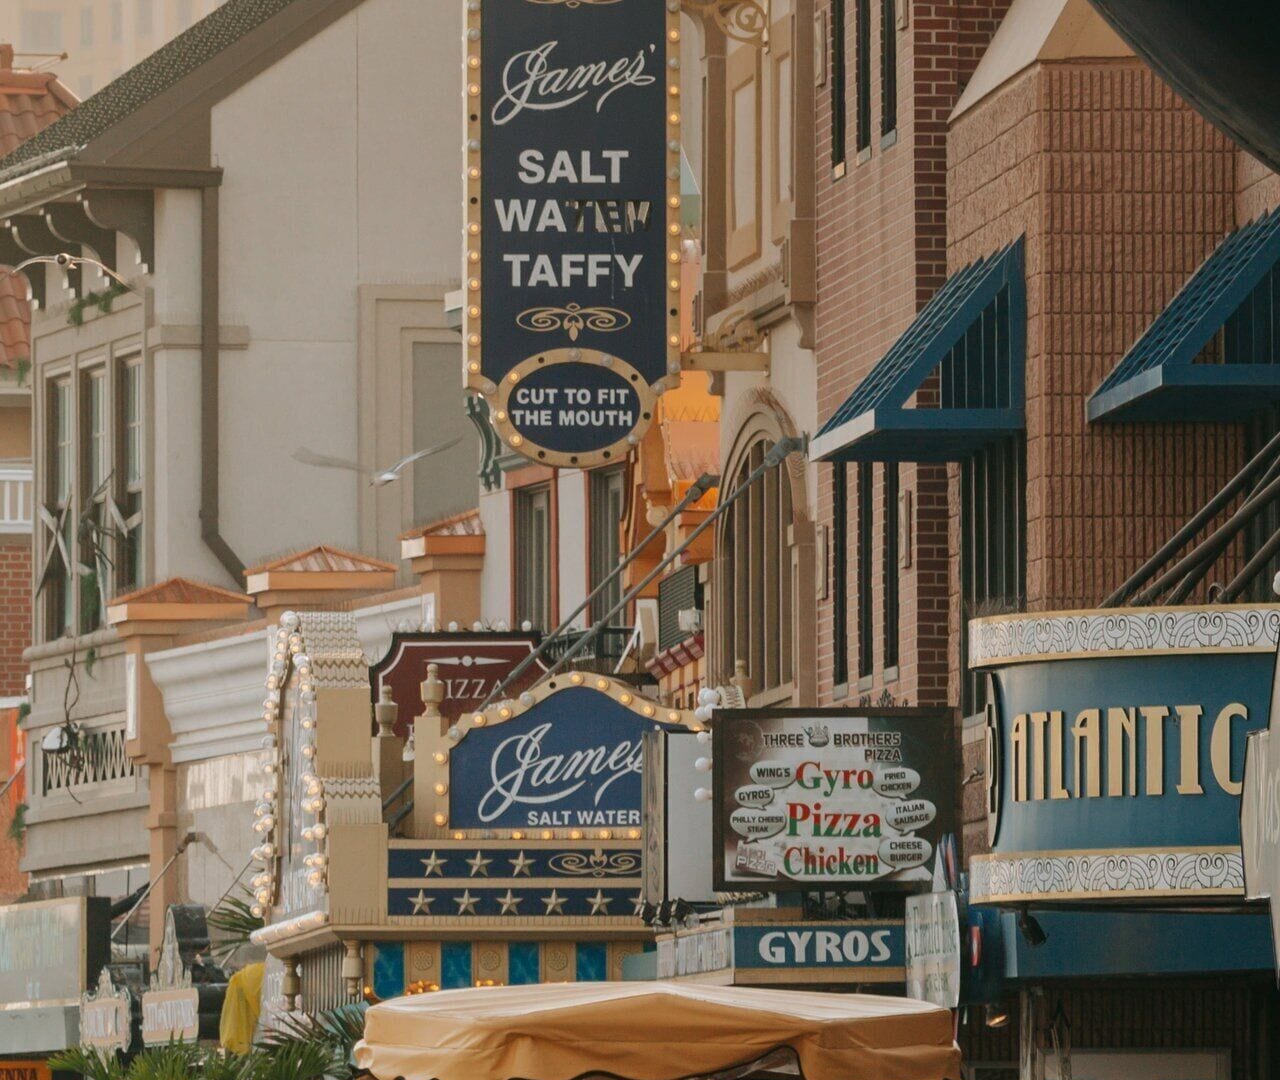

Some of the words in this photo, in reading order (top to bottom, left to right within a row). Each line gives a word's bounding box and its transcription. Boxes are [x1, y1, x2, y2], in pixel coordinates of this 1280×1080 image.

[492, 41, 656, 125] James'
[518, 149, 630, 184] SALT
[503, 254, 643, 288] TAFFY
[516, 388, 558, 405] CUT
[564, 388, 591, 405] TO
[597, 388, 629, 405] FIT
[512, 410, 552, 426] THE
[559, 410, 633, 426] MOUTH
[446, 679, 508, 699] IZZA
[763, 734, 803, 746] THREE
[834, 733, 901, 746] BROTHERS
[864, 749, 901, 762] PIZZA
[1011, 702, 1247, 802] ATLANTIC
[796, 761, 874, 797] Gyro
[884, 772, 906, 781] FRIED
[881, 781, 912, 792] CHICKEN
[739, 790, 771, 802] GYROS
[895, 803, 925, 815] ITALIAN
[528, 811, 572, 826] SALT
[578, 810, 640, 826] WATER
[759, 815, 785, 824] CHEESE
[786, 803, 882, 837] Pizza
[894, 814, 930, 826] SAUSAGE
[747, 826, 769, 834] STEAK
[890, 840, 923, 850] CHEESE
[784, 847, 879, 876] Chicken
[890, 852, 924, 863] BURGER
[758, 930, 891, 963] GYROS
